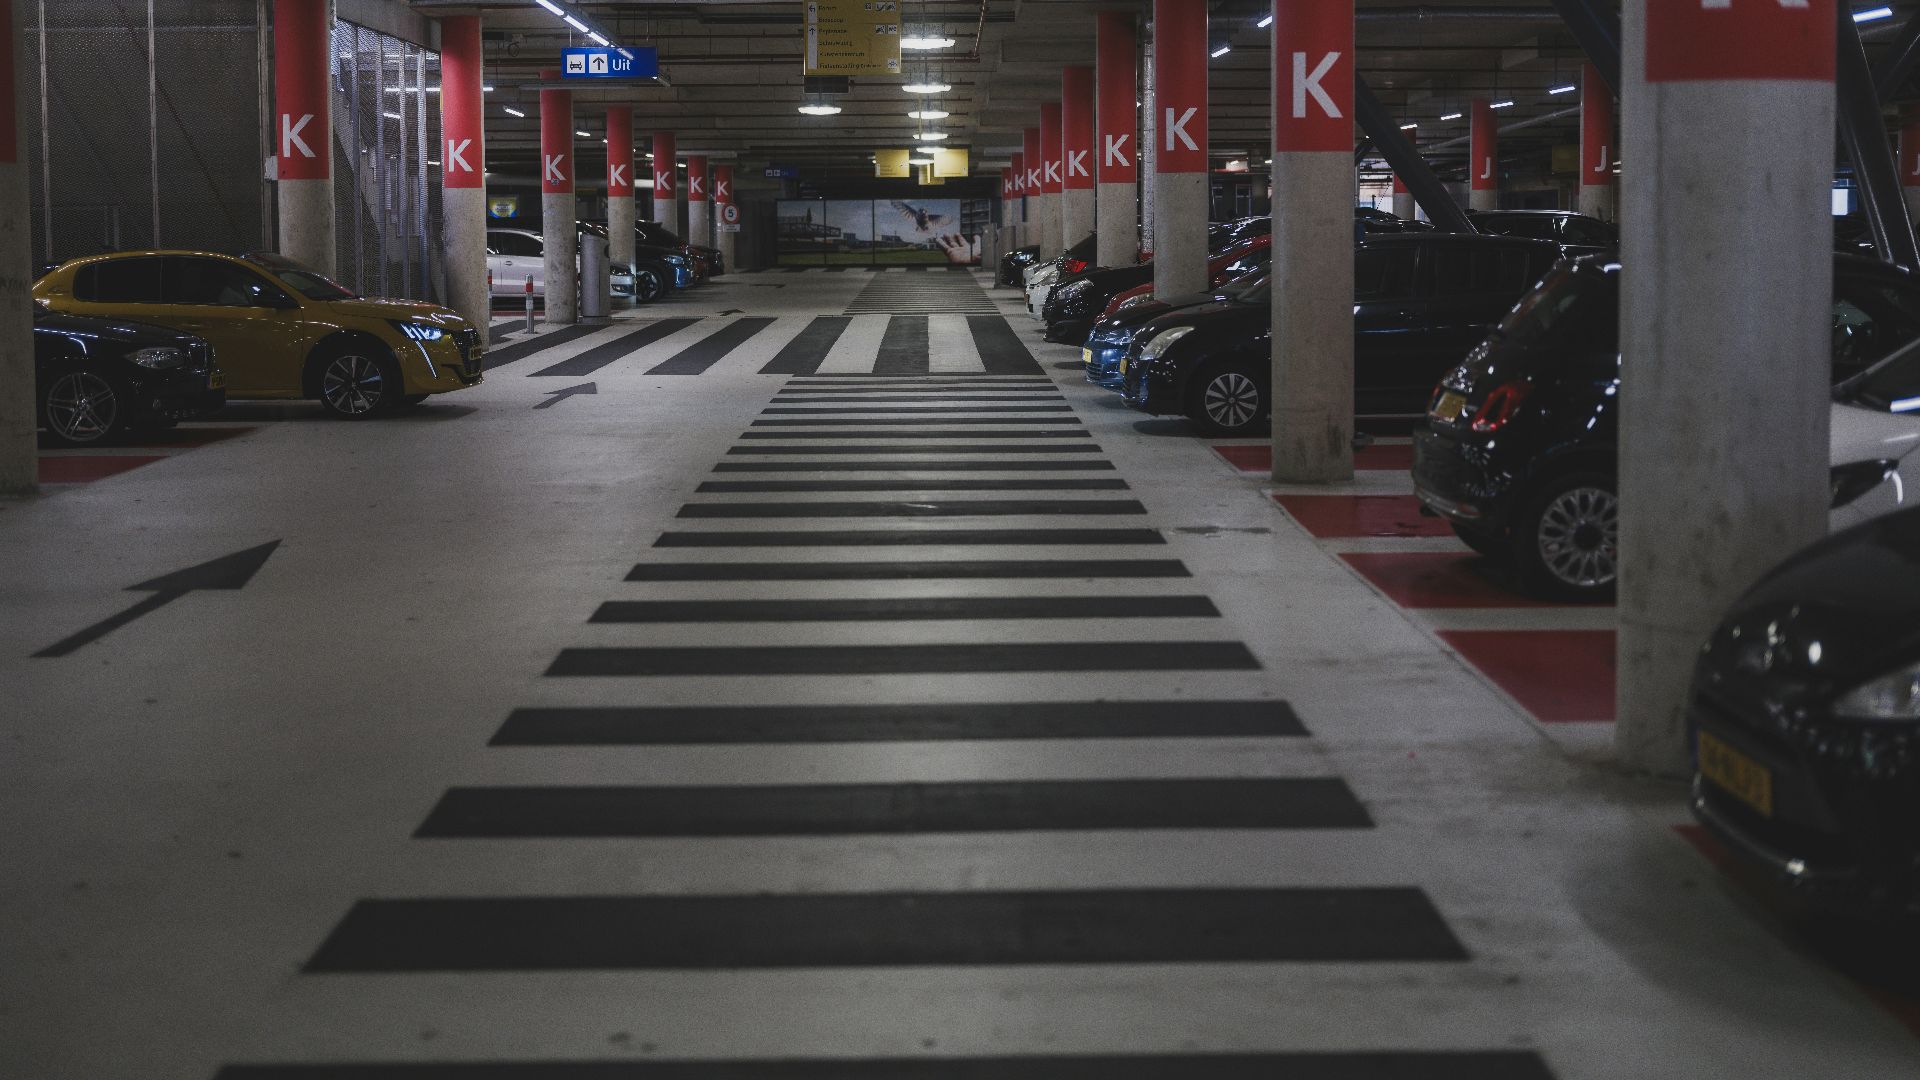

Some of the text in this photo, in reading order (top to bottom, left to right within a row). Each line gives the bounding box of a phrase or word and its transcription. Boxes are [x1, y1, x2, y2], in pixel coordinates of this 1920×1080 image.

[612, 59, 631, 71] Uit
[1292, 51, 1343, 118] K
[282, 113, 316, 158] K
[1166, 107, 1199, 150] K
[447, 138, 474, 173] K
[1105, 134, 1131, 167] K
[1595, 146, 1607, 172] J
[545, 154, 566, 182] K
[1045, 161, 1061, 183] K
[1069, 150, 1090, 177] K
[1481, 157, 1491, 178] J
[610, 164, 627, 187] K
[656, 171, 671, 191] K
[690, 176, 703, 194] K
[1015, 174, 1024, 191] K
[1028, 168, 1041, 188] K
[717, 181, 728, 196] K
[728, 208, 734, 218] 5
